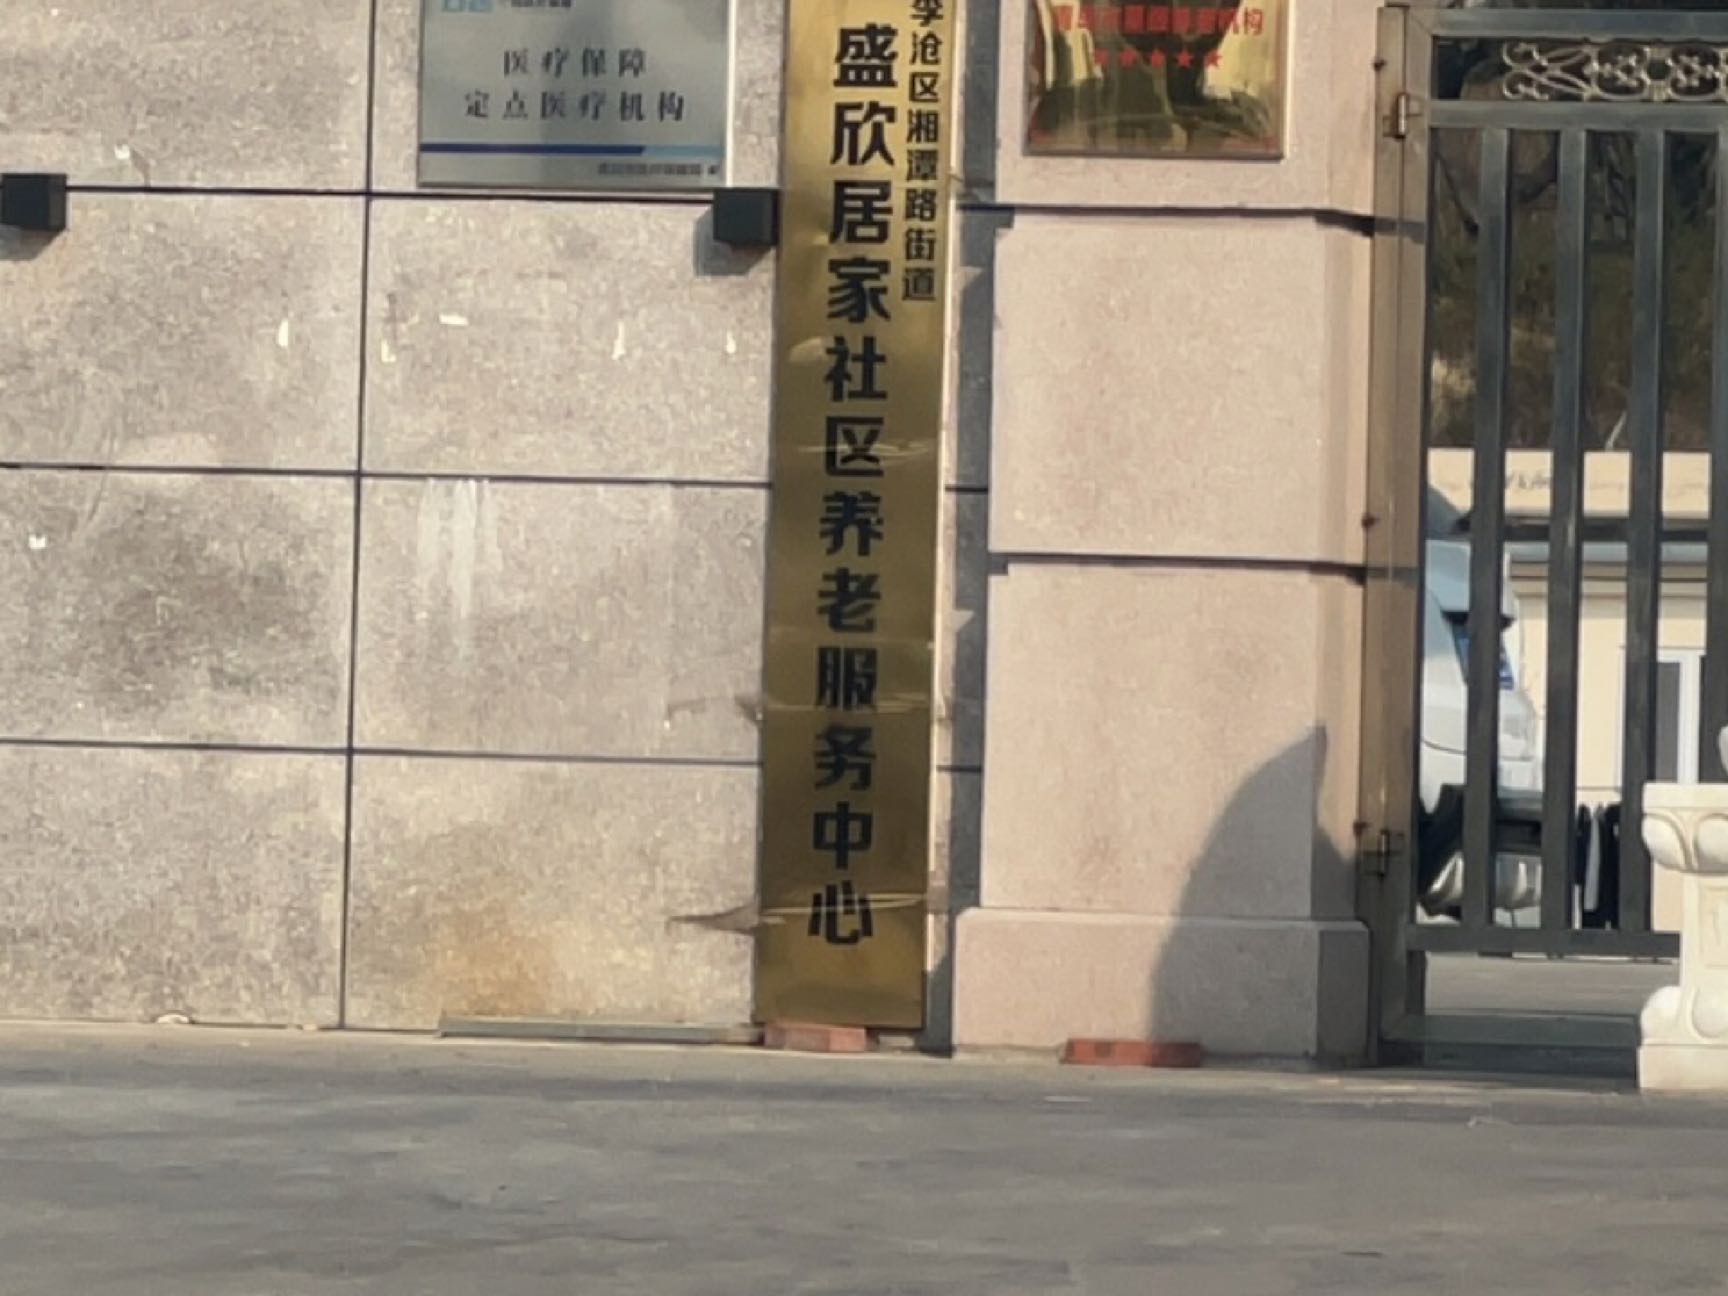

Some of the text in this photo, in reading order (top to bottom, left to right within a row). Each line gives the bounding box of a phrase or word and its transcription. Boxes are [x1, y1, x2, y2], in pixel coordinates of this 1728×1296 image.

[503, 48, 646, 79] 医疗保障
[464, 88, 685, 122] 定点医疗机构
[807, 22, 899, 946] 盛欣居家社区养老服务中心
